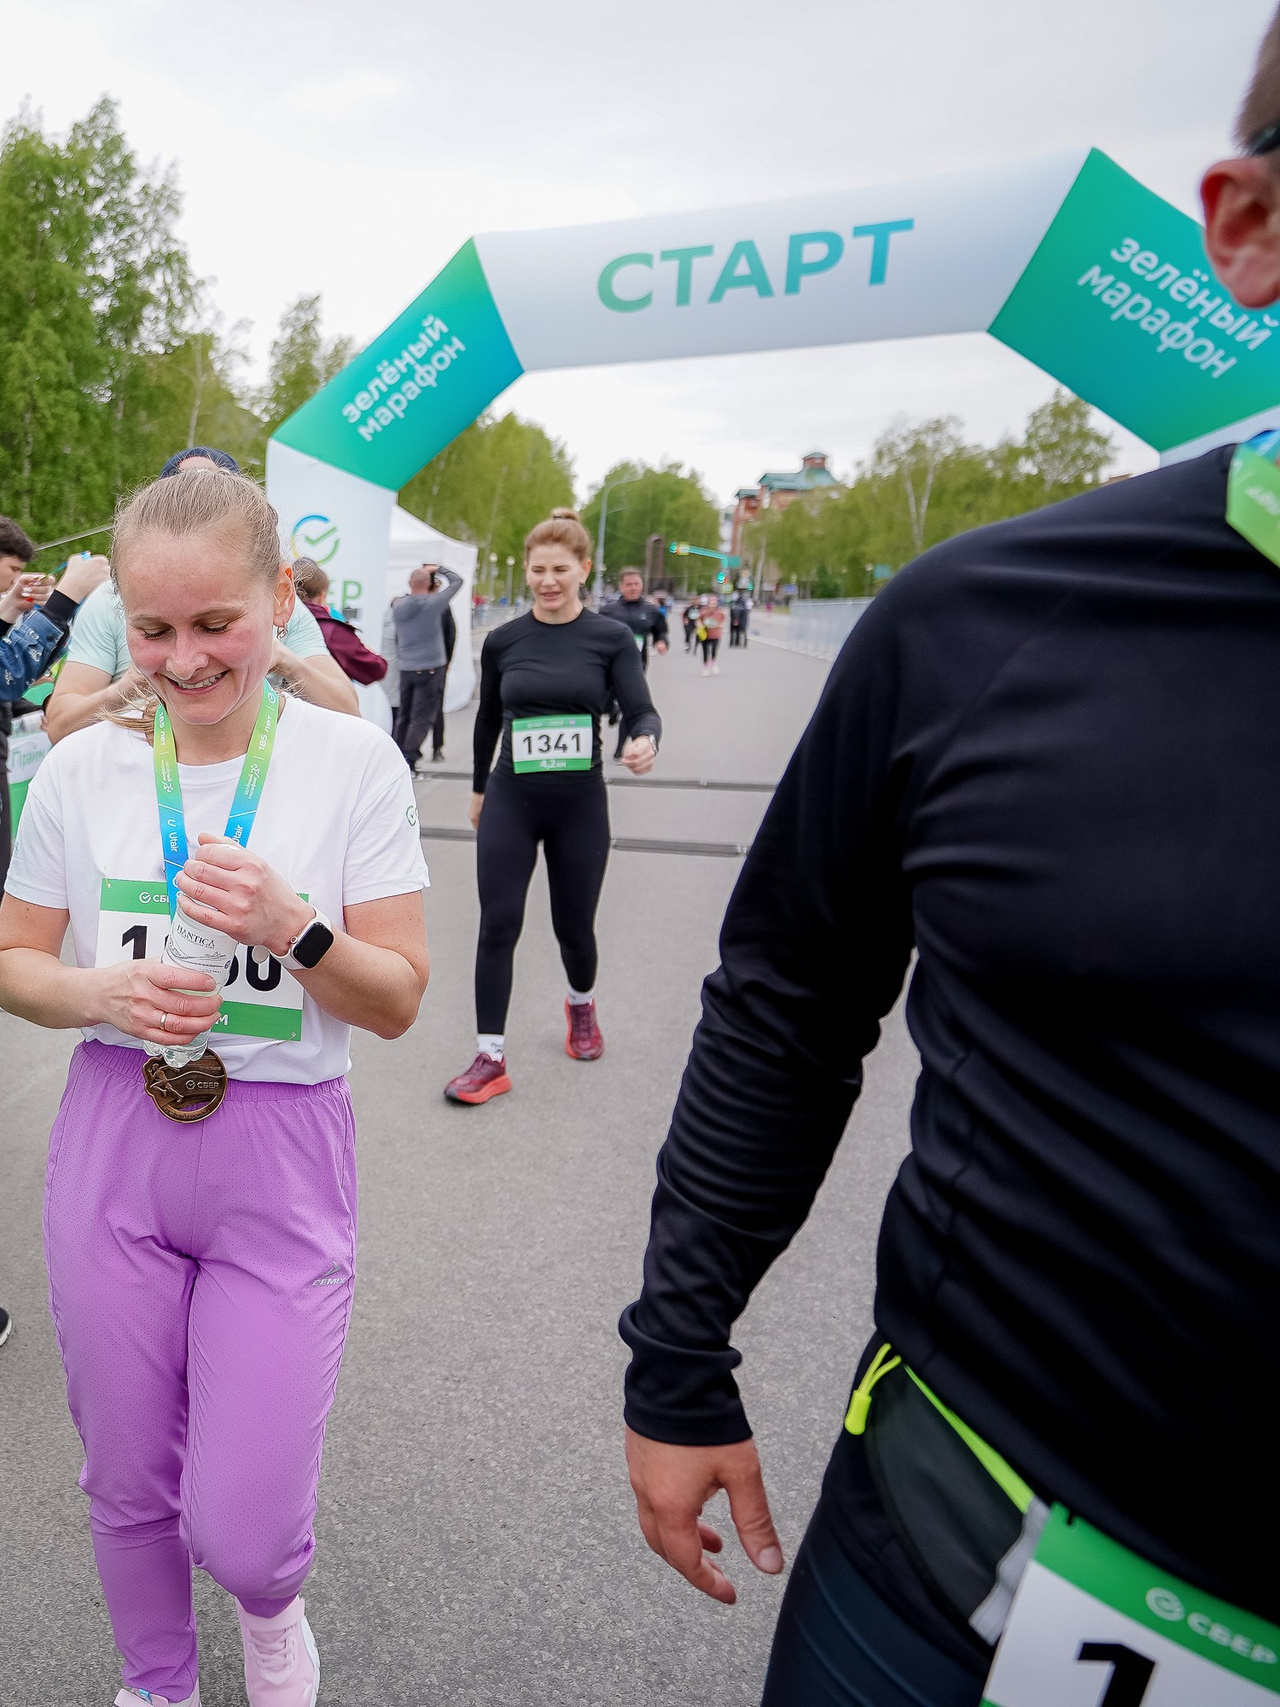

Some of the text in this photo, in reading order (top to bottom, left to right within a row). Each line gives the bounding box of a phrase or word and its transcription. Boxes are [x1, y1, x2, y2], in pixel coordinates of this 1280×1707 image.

[597, 218, 915, 314] СТАРТ
[1110, 237, 1280, 351] зелёный
[342, 314, 449, 424] зелёный
[1077, 264, 1238, 379] марафон
[357, 336, 466, 442] марафон
[258, 733, 268, 751] 185
[522, 733, 581, 755] 1341
[168, 832, 178, 853] Utair
[1186, 1611, 1278, 1665] СБЕР
